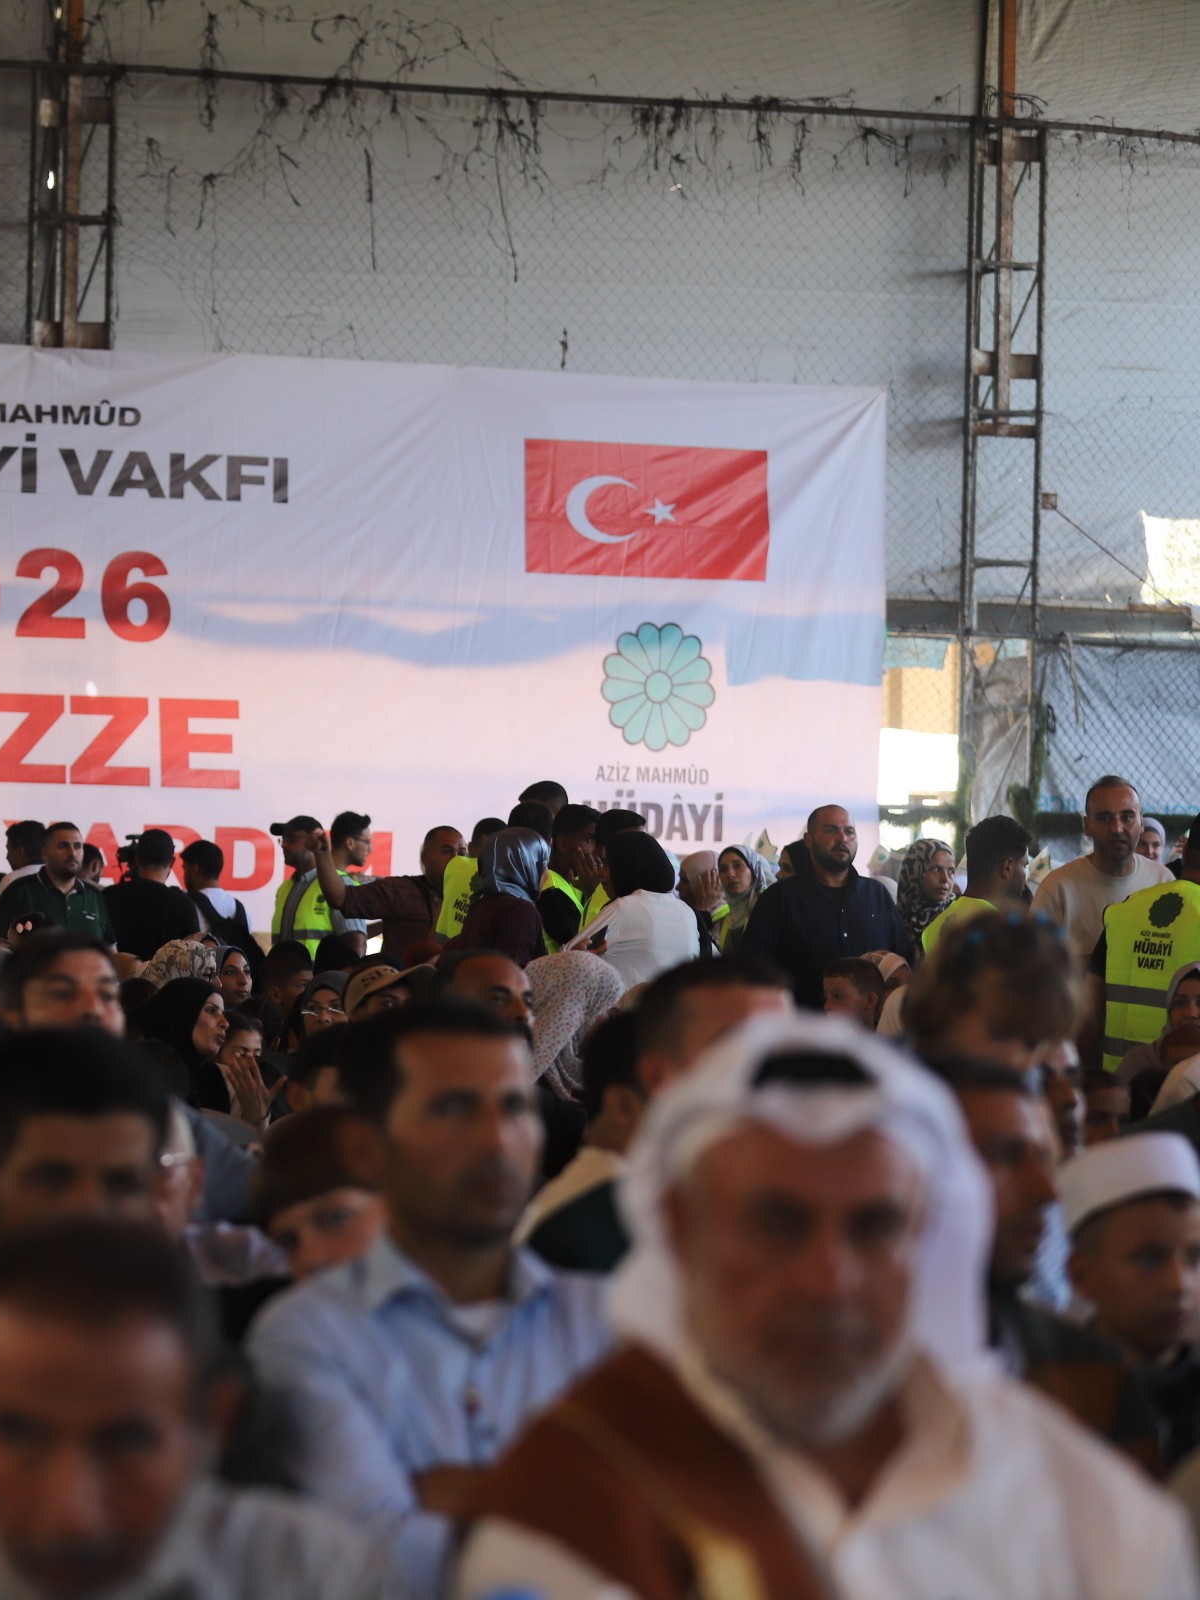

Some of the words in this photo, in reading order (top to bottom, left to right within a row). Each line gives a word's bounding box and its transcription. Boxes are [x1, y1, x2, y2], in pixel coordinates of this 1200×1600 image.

[58, 448, 289, 503] VAKFI
[595, 762, 630, 782] AZİZ
[636, 764, 709, 785] MAHMÛD
[1137, 956, 1165, 971] VAKFI
